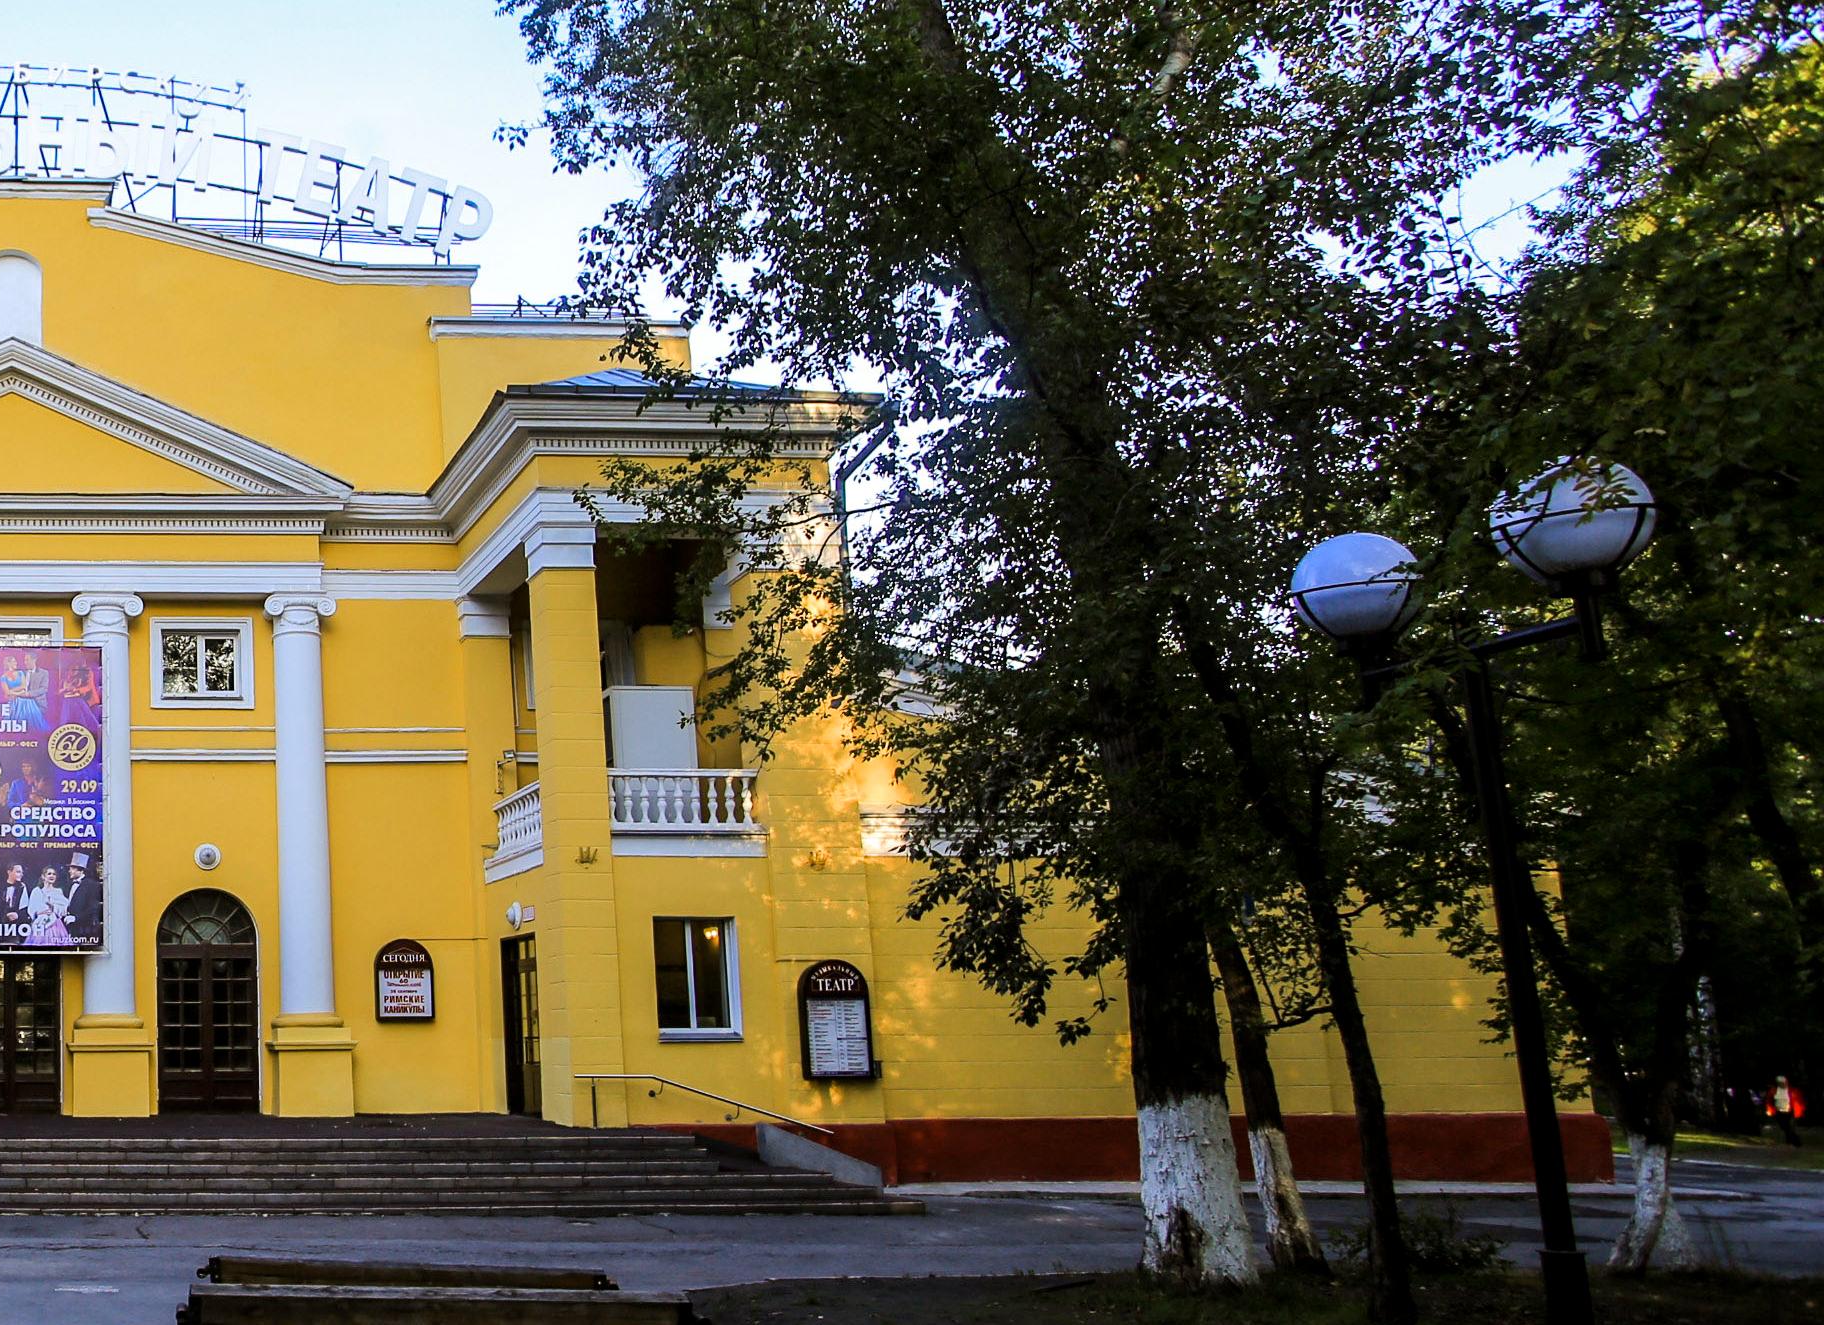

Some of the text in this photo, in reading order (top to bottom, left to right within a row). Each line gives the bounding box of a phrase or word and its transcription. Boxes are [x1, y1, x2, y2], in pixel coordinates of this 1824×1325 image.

[255, 127, 494, 258] ТЕАТР
[61, 780, 97, 793] 29.09
[10, 806, 96, 822] СРЕДСТВО
[51, 936, 99, 944] muzkom.ru
[382, 954, 425, 963] СЕГОДНЯ
[817, 978, 854, 991] ТЕАТР
[384, 995, 424, 1003] РИМСКИЕ
[384, 1005, 425, 1014] КАНИКУЛЫ
